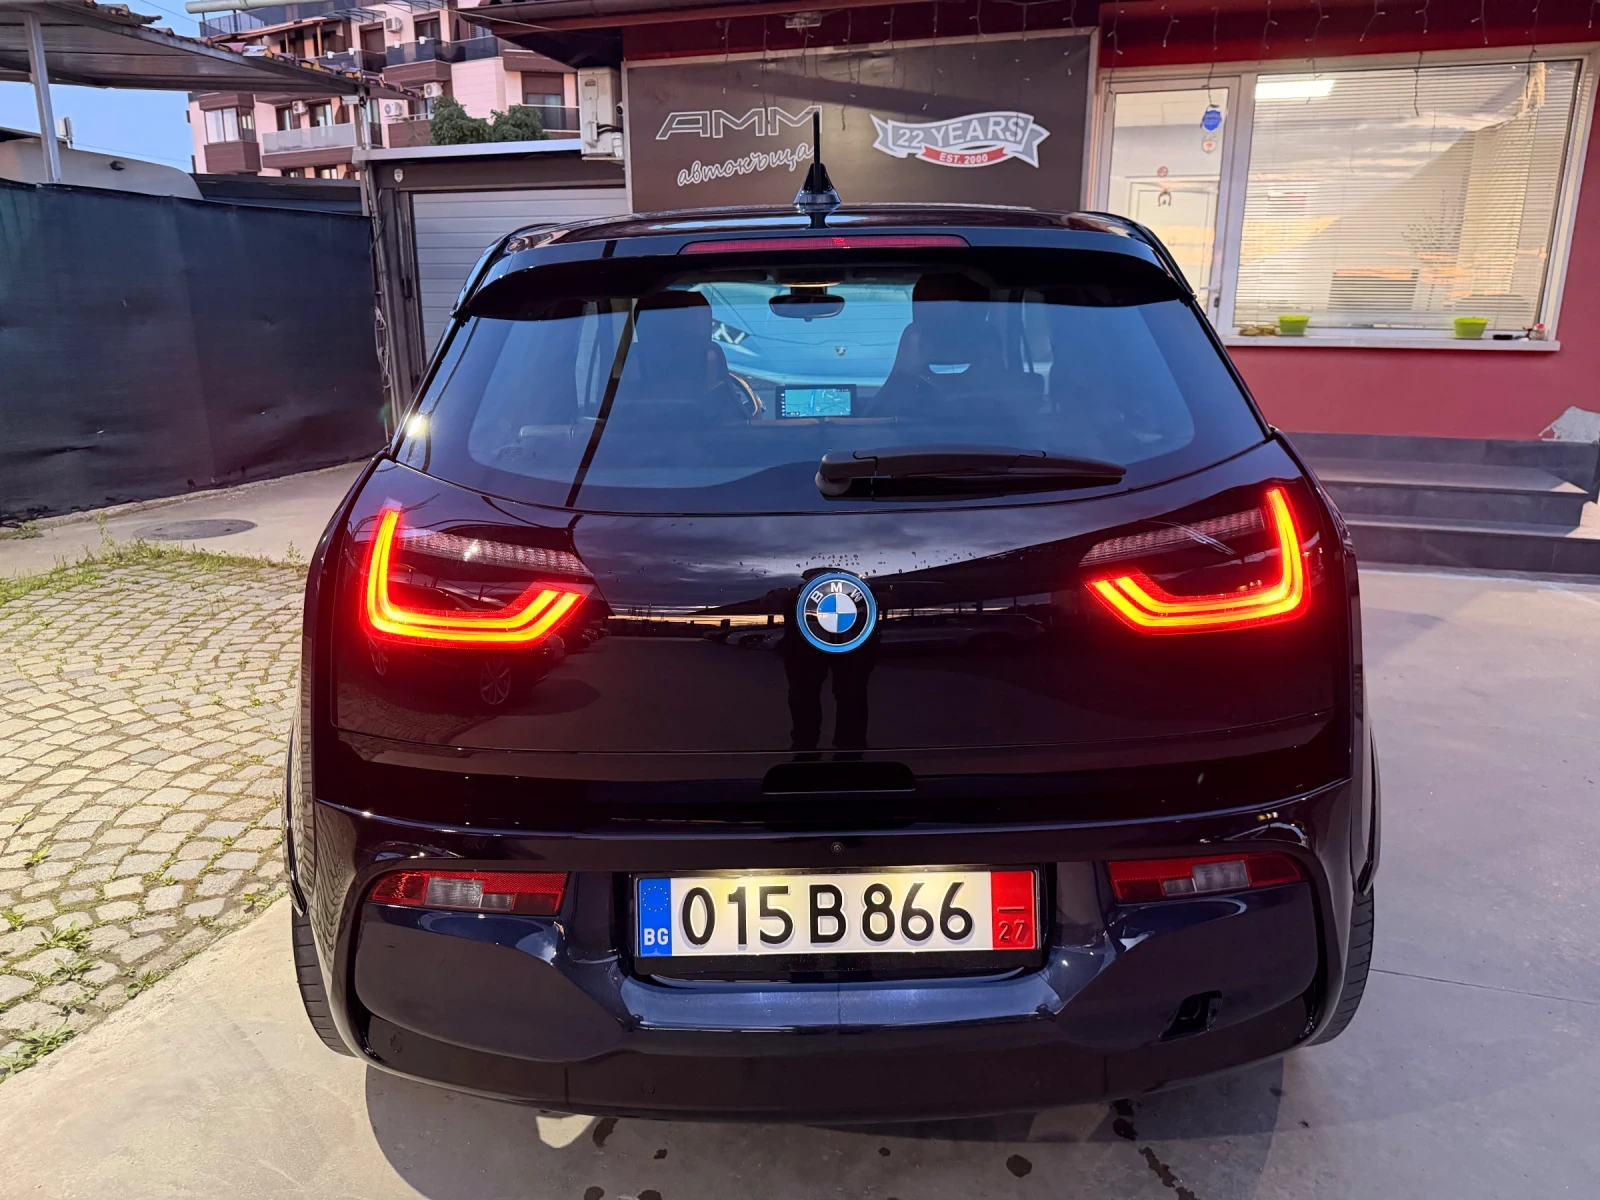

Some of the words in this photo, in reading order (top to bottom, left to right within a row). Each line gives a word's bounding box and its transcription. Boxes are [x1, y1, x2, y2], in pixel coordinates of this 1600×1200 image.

[896, 128, 925, 148] 22
[930, 116, 1025, 147] YEARS
[677, 142, 816, 187] автокъща
[939, 152, 961, 164] EST.
[963, 153, 989, 165] 2000
[810, 582, 863, 603] BMW
[643, 927, 669, 946] BG
[998, 920, 1026, 942] 27
